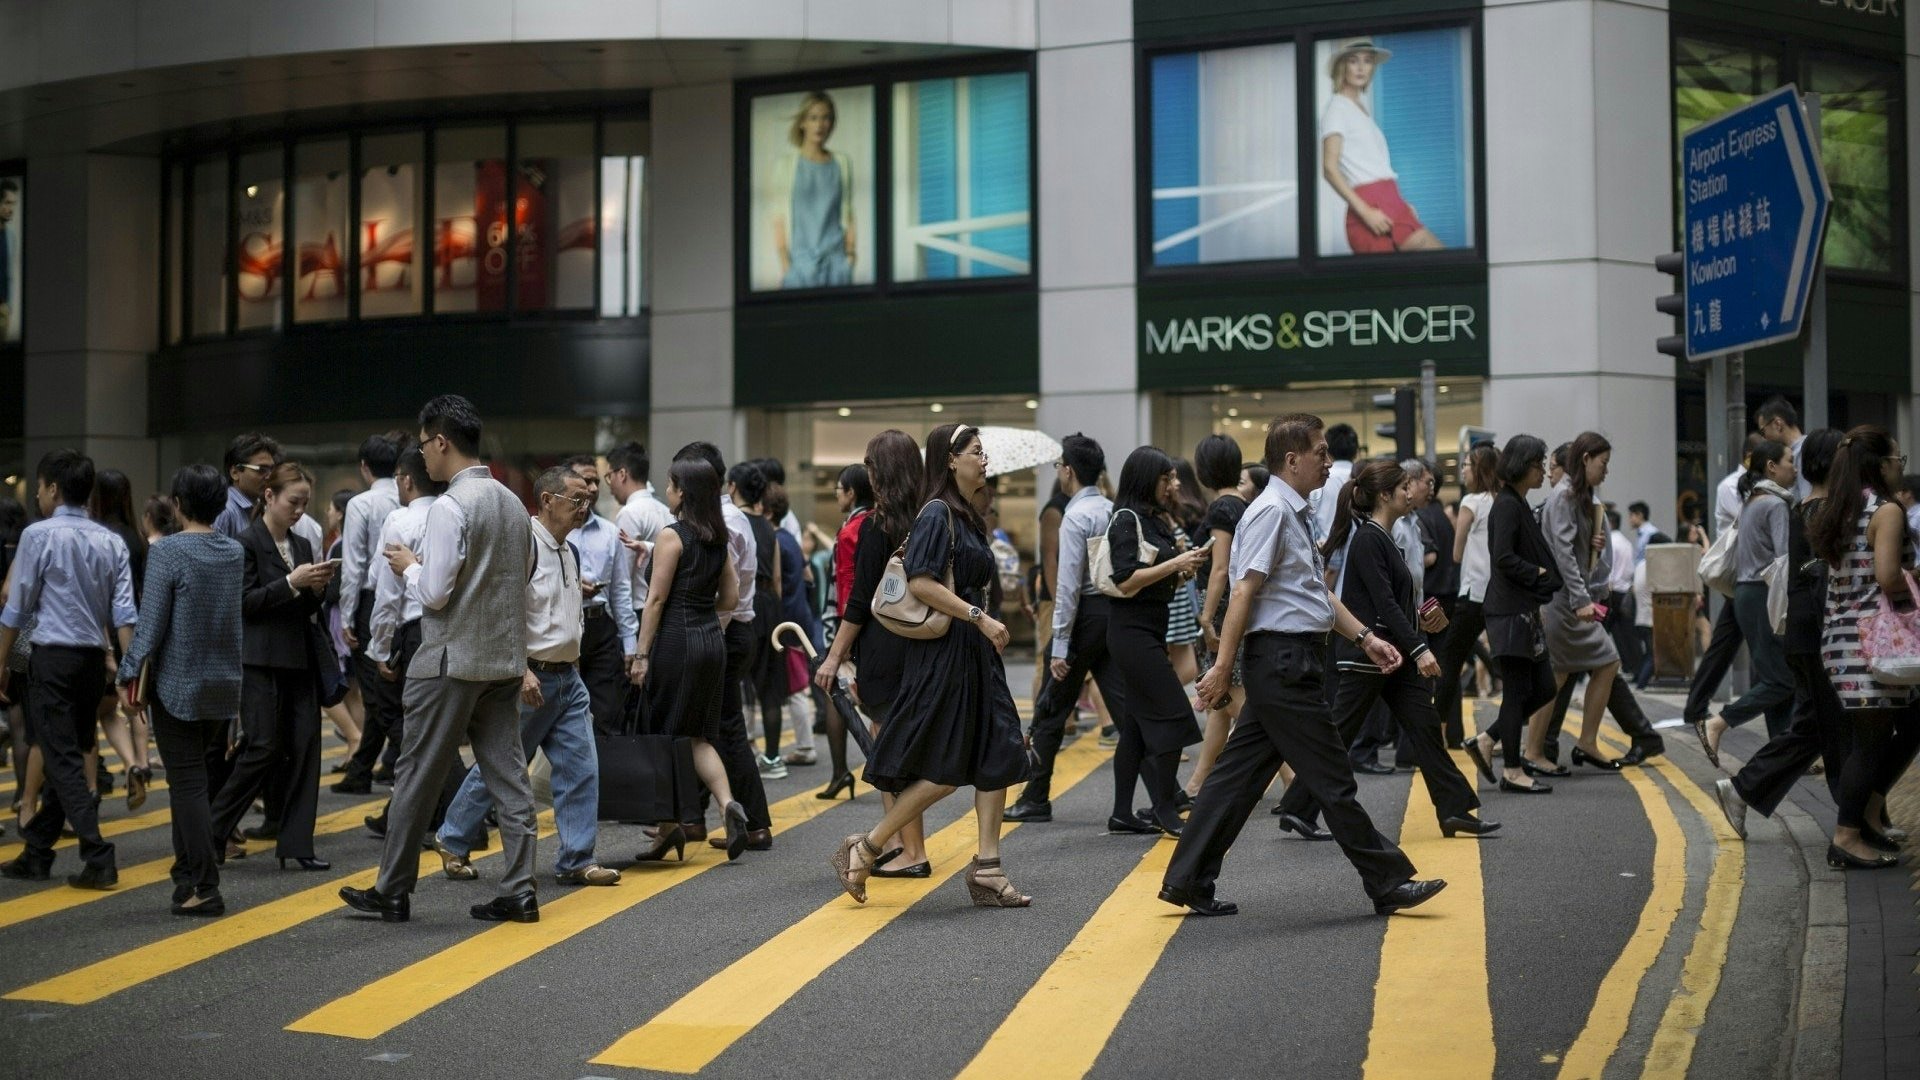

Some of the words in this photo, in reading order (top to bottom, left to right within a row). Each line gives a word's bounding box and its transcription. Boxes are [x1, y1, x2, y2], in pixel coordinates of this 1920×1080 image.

[1690, 137, 1726, 174] Airport
[1728, 120, 1777, 158] Express
[1690, 173, 1728, 204] Station
[1691, 255, 1737, 286] Kowloon
[1693, 298, 1723, 337] 九龍
